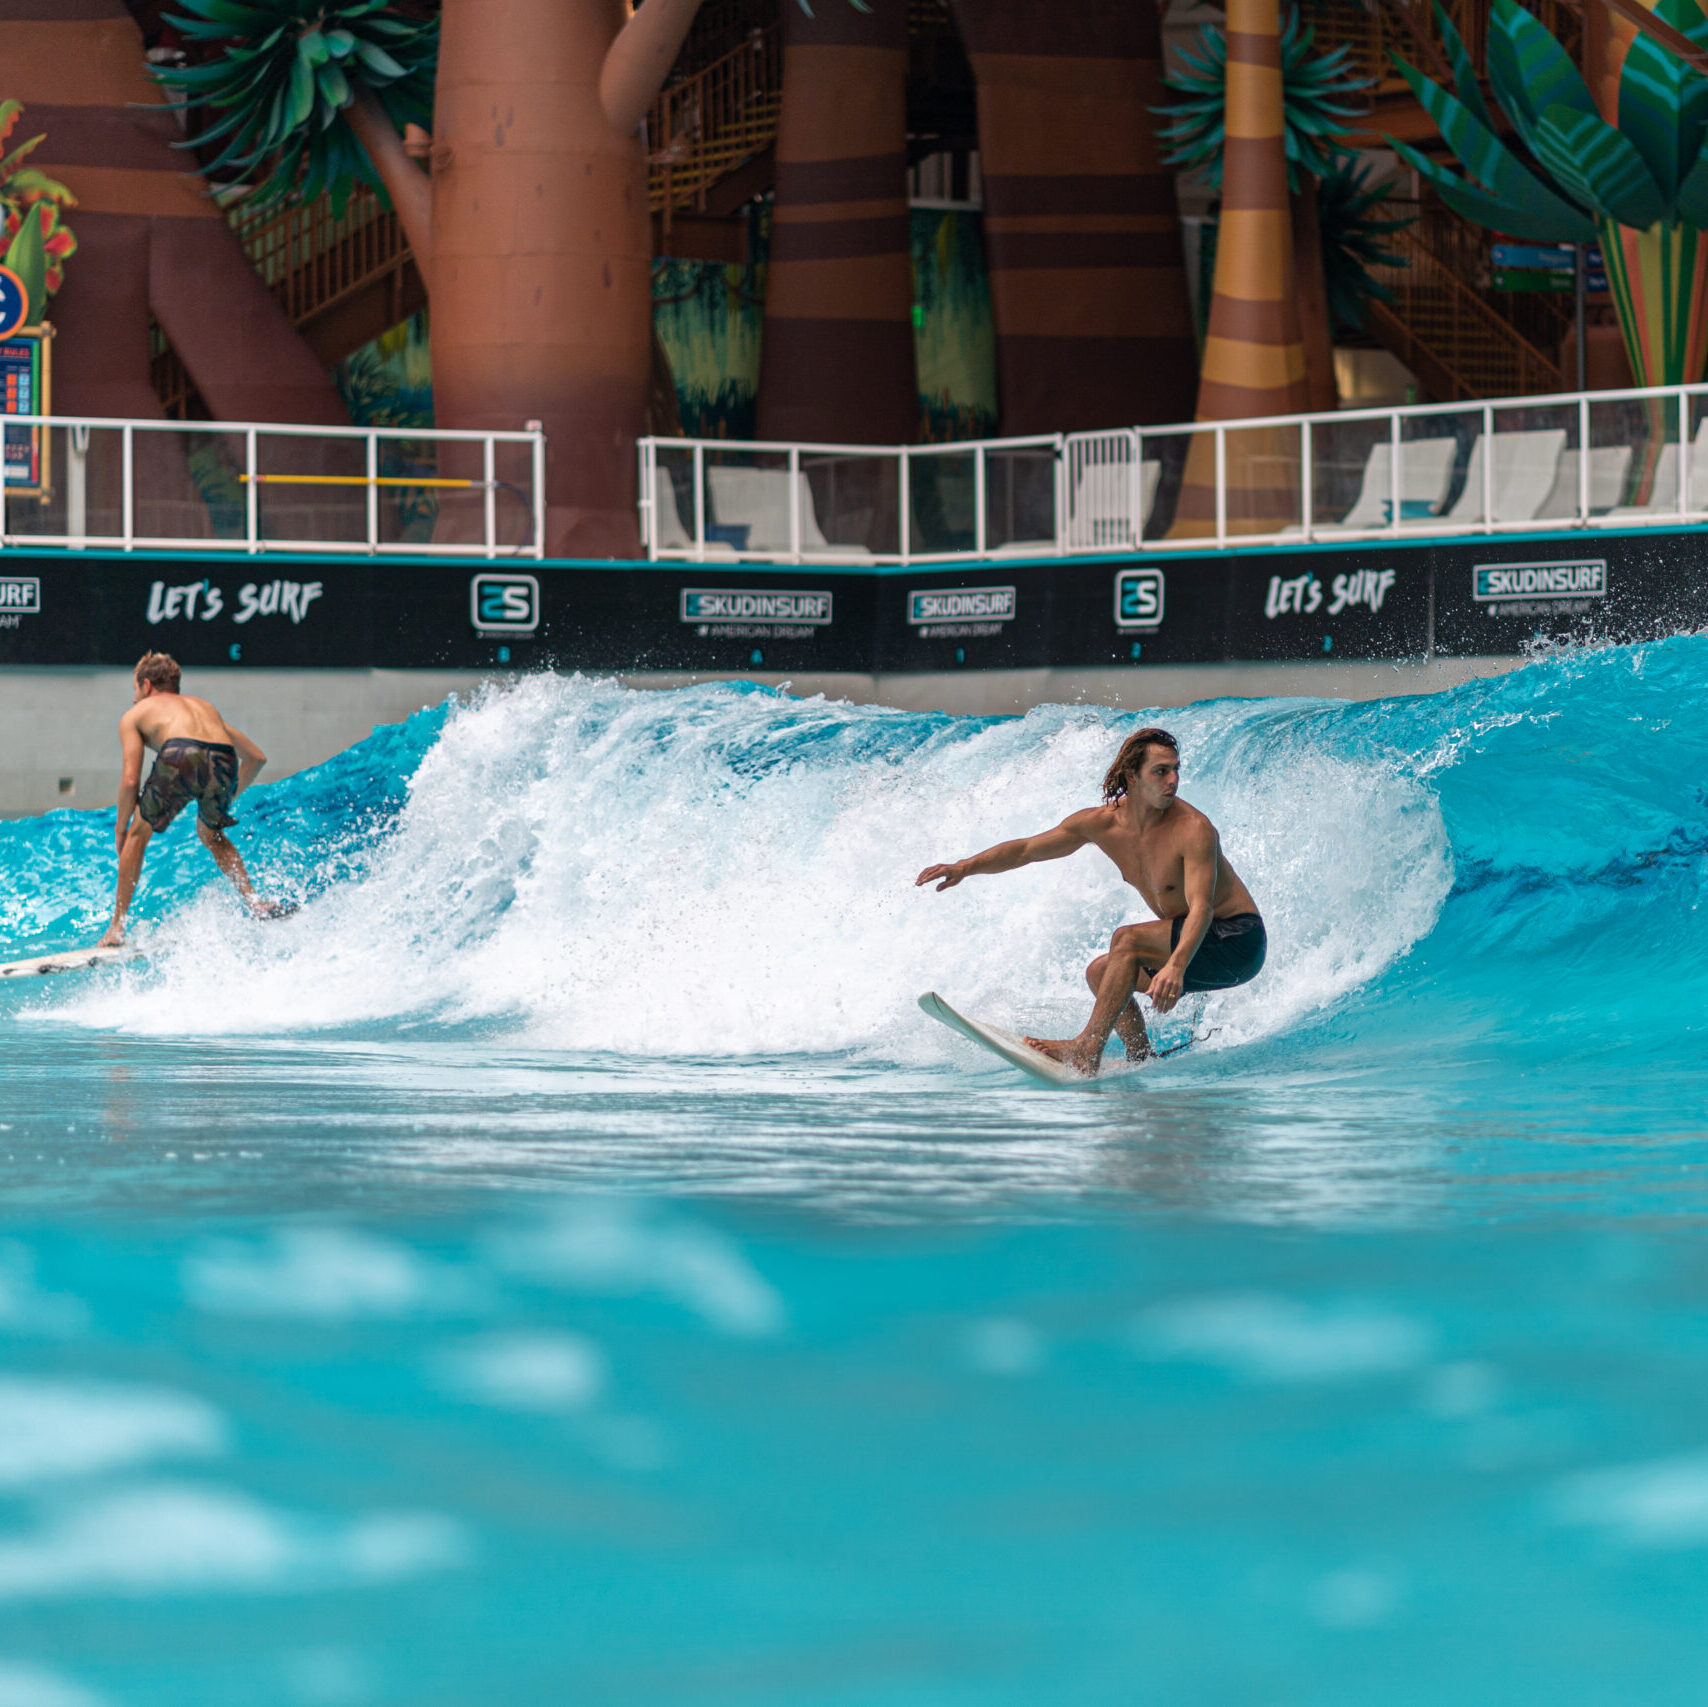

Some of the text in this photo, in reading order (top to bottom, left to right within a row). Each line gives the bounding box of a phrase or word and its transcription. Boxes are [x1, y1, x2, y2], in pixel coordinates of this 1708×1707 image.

[146, 578, 323, 624] LET'S SURF
[1265, 569, 1396, 618] LET'S SURF
